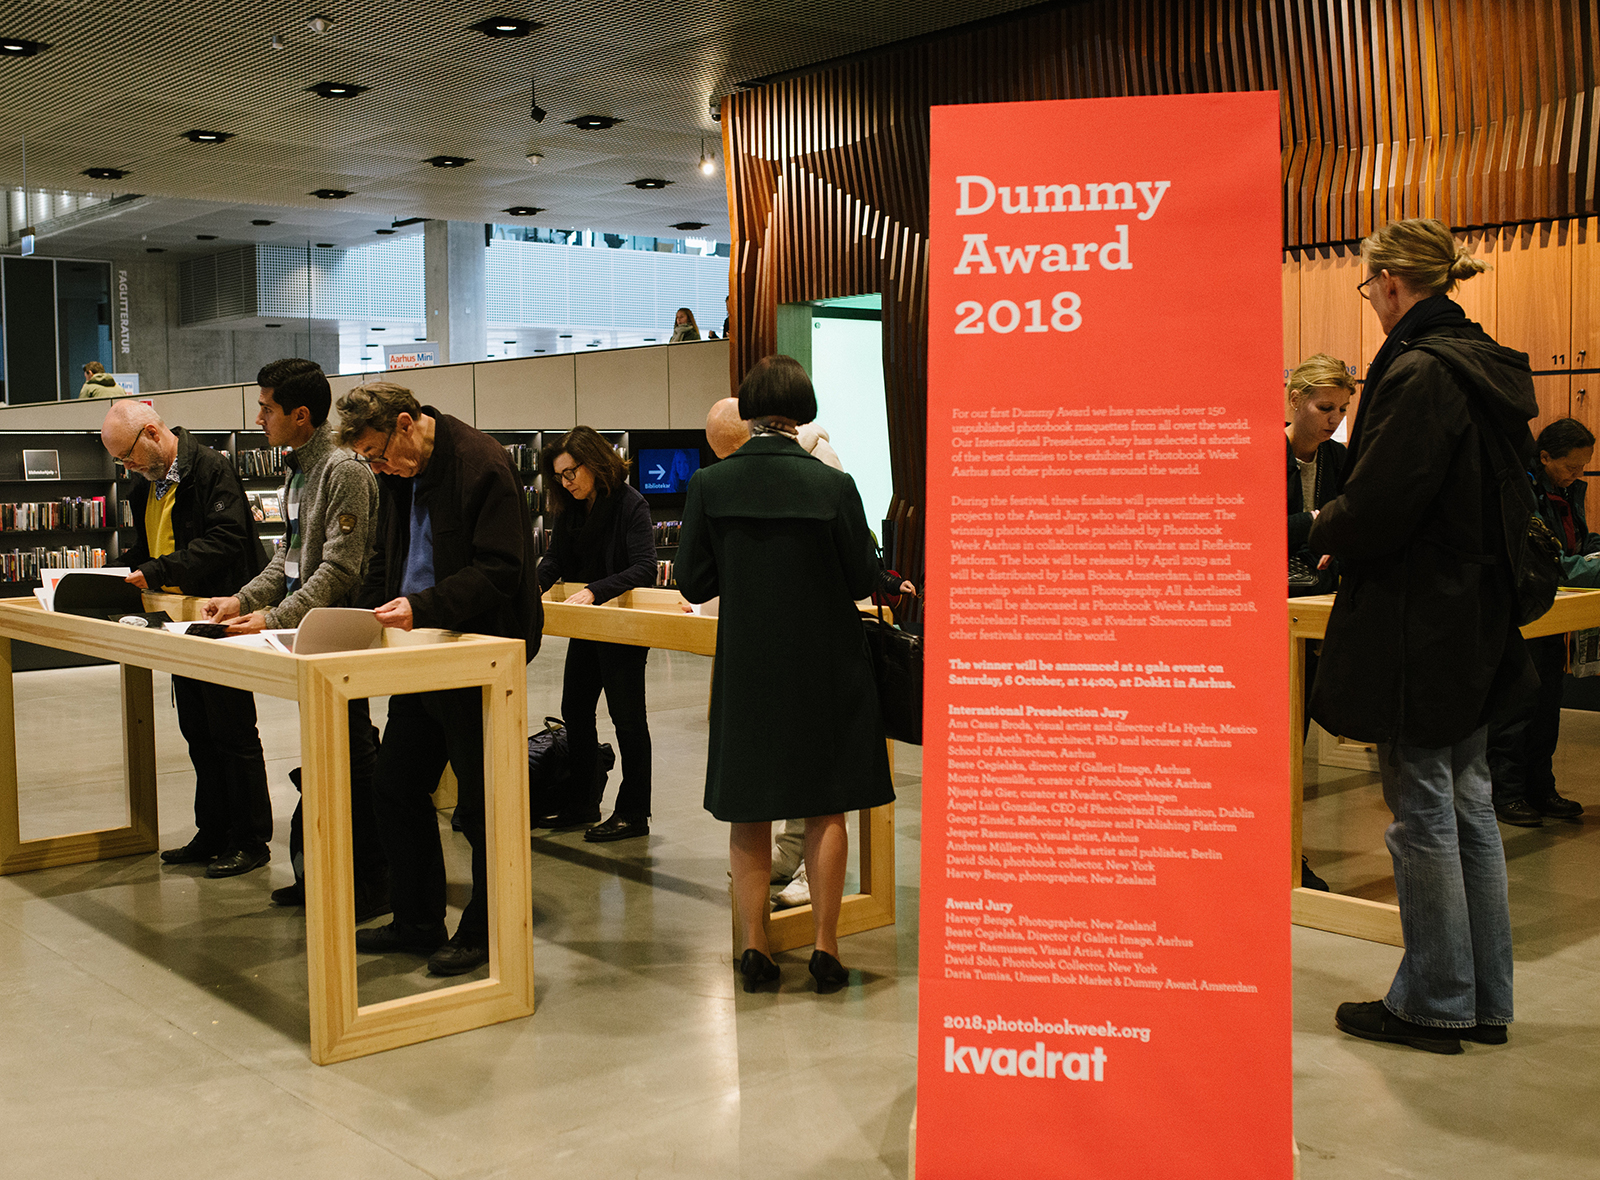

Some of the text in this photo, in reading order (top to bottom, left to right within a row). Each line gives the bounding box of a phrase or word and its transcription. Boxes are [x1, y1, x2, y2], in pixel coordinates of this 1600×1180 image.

[955, 175, 1171, 221] Dummy
[953, 224, 1133, 275] Award
[118, 270, 130, 354] FAGLITTERATUR
[954, 291, 1083, 335] 2018
[390, 353, 433, 363] Aarhus Mini
[1552, 354, 1565, 365] 11
[952, 408, 968, 418] For
[989, 407, 1010, 417] first
[1011, 407, 1054, 419] Dummy
[1056, 406, 1090, 416] Award
[1091, 408, 1107, 416] we
[1108, 406, 1133, 415] have
[1135, 405, 1180, 415] received
[951, 422, 1015, 434] unpublished
[1016, 421, 1072, 434] photobook
[1130, 420, 1156, 430] from
[1157, 420, 1171, 430] all
[1172, 422, 1196, 430] over
[1197, 419, 1216, 429] the
[951, 437, 972, 447] Our
[975, 436, 1040, 447] International
[1042, 436, 1105, 446] Preselection
[1108, 435, 1131, 447] Jury
[1133, 435, 1152, 445] has
[1153, 435, 1197, 445] selected
[1208, 434, 1251, 444] shortlist
[950, 449, 1238, 461] of the best dummies to be exhibited at Photobook Week
[951, 466, 988, 476] Aarhus
[990, 466, 1010, 476] and
[1011, 466, 1039, 475] other
[1040, 465, 1072, 477] photo
[1073, 465, 1108, 475] events
[1109, 465, 1147, 475] around
[1148, 465, 1166, 474] the
[950, 495, 988, 507] During
[990, 495, 1007, 505] the
[1050, 495, 1079, 505] three
[1080, 495, 1122, 504] finalists
[1124, 495, 1143, 504] will
[1145, 494, 1186, 506] present
[1188, 494, 1214, 504] their
[1215, 494, 1244, 504] book
[950, 525, 1222, 537] winning photobook will be published by Photobook
[949, 569, 968, 579] will
[970, 569, 984, 579] be
[986, 569, 1043, 579] distributed
[1045, 570, 1059, 581] by
[1061, 570, 1085, 579] Idea
[1193, 570, 1205, 580] in
[1216, 570, 1251, 580] media
[949, 599, 981, 609] books
[983, 599, 1002, 609] will
[1004, 600, 1018, 609] be
[1020, 600, 1077, 609] showcased
[1079, 601, 1090, 609] at
[1092, 600, 1150, 610] Photobook
[1154, 600, 1184, 610] Week
[1187, 601, 1227, 610] Aarhus
[948, 629, 976, 639] other
[979, 629, 1022, 639] festivals
[1023, 630, 1062, 640] around
[1063, 630, 1082, 640] the
[950, 658, 971, 669] The
[972, 659, 1012, 669] winner
[1015, 659, 1036, 670] will
[1038, 660, 1053, 670] be
[1054, 660, 1119, 671] announced
[1120, 662, 1133, 671] at
[1144, 661, 1170, 674] gala
[1171, 662, 1206, 672] event
[948, 674, 1003, 687] Saturday,
[1014, 675, 1065, 687] October,
[1066, 676, 1079, 686] at
[1081, 678, 1117, 688] 14:00,
[1118, 677, 1131, 687] at
[1172, 677, 1186, 687] in
[1187, 677, 1236, 688] Aarhus.
[948, 704, 1128, 719] International Preselection Jury
[947, 718, 967, 728] Ana
[1034, 720, 1063, 730] visual
[1066, 720, 1090, 730] artist
[1093, 721, 1112, 731] and
[1115, 721, 1154, 732] director
[1154, 722, 1166, 732] of
[1167, 722, 1181, 732] La
[1219, 723, 1258, 733] Mexico
[947, 745, 980, 755] School
[982, 746, 992, 755] of
[1059, 748, 1096, 758] Aarhus
[945, 827, 978, 839] Jesper
[1040, 830, 1069, 840] visual
[1102, 832, 1139, 842] Aarhus
[945, 854, 975, 864] David
[1003, 856, 1056, 869] photobook
[1105, 859, 1128, 869] New
[1131, 860, 1155, 870] York
[945, 898, 1012, 912] Award Jury
[945, 912, 979, 925] Harvey
[1090, 918, 1113, 929] New
[1115, 919, 1156, 930] Zealand
[944, 926, 972, 937] Beate
[1027, 930, 1067, 941] Director
[1070, 932, 1080, 942] of
[1082, 932, 1117, 943] Galleri
[1155, 935, 1193, 946] Aarhus
[943, 1014, 1151, 1043] 2018.photobookweek.org
[944, 1036, 1108, 1082] kvadrat
